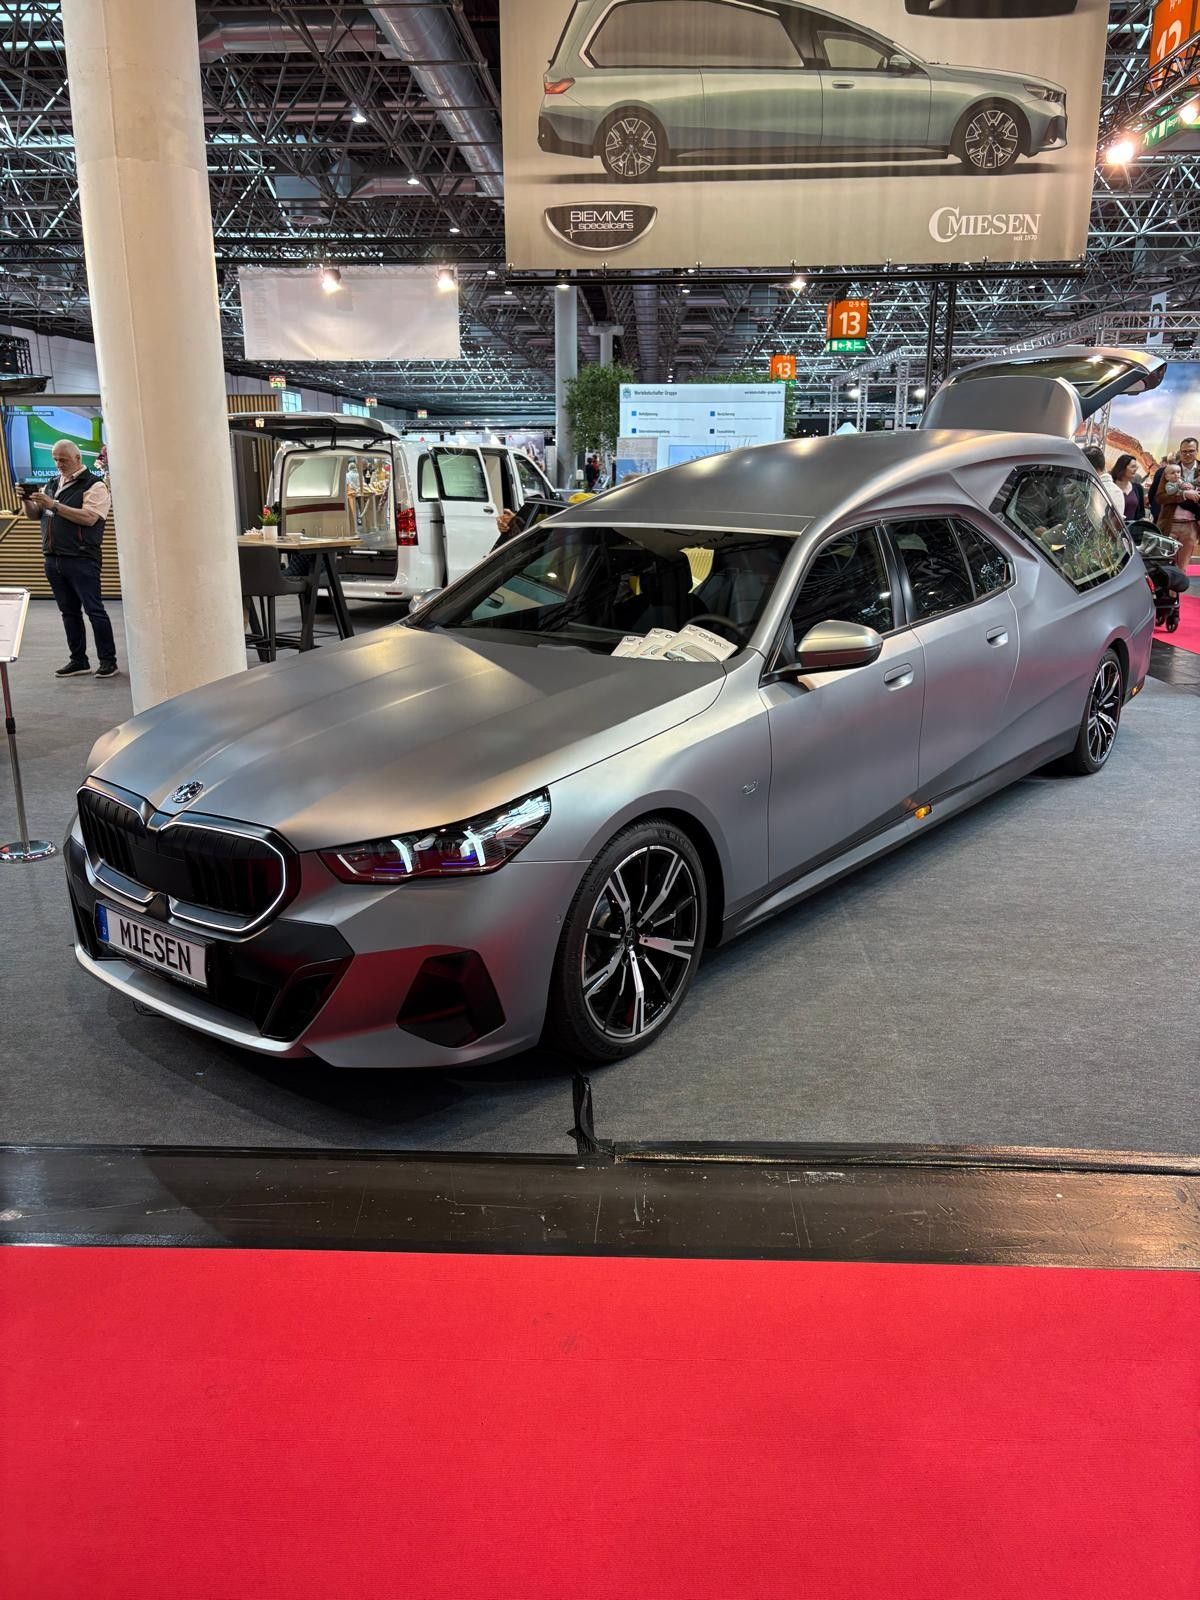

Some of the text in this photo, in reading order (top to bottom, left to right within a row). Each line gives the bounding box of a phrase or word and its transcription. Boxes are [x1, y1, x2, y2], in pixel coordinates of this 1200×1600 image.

[570, 210, 634, 222] BIEMME
[578, 221, 634, 231] specialcars
[839, 311, 861, 336] 13
[776, 362, 792, 379] 13
[119, 918, 192, 975] MIESEN
